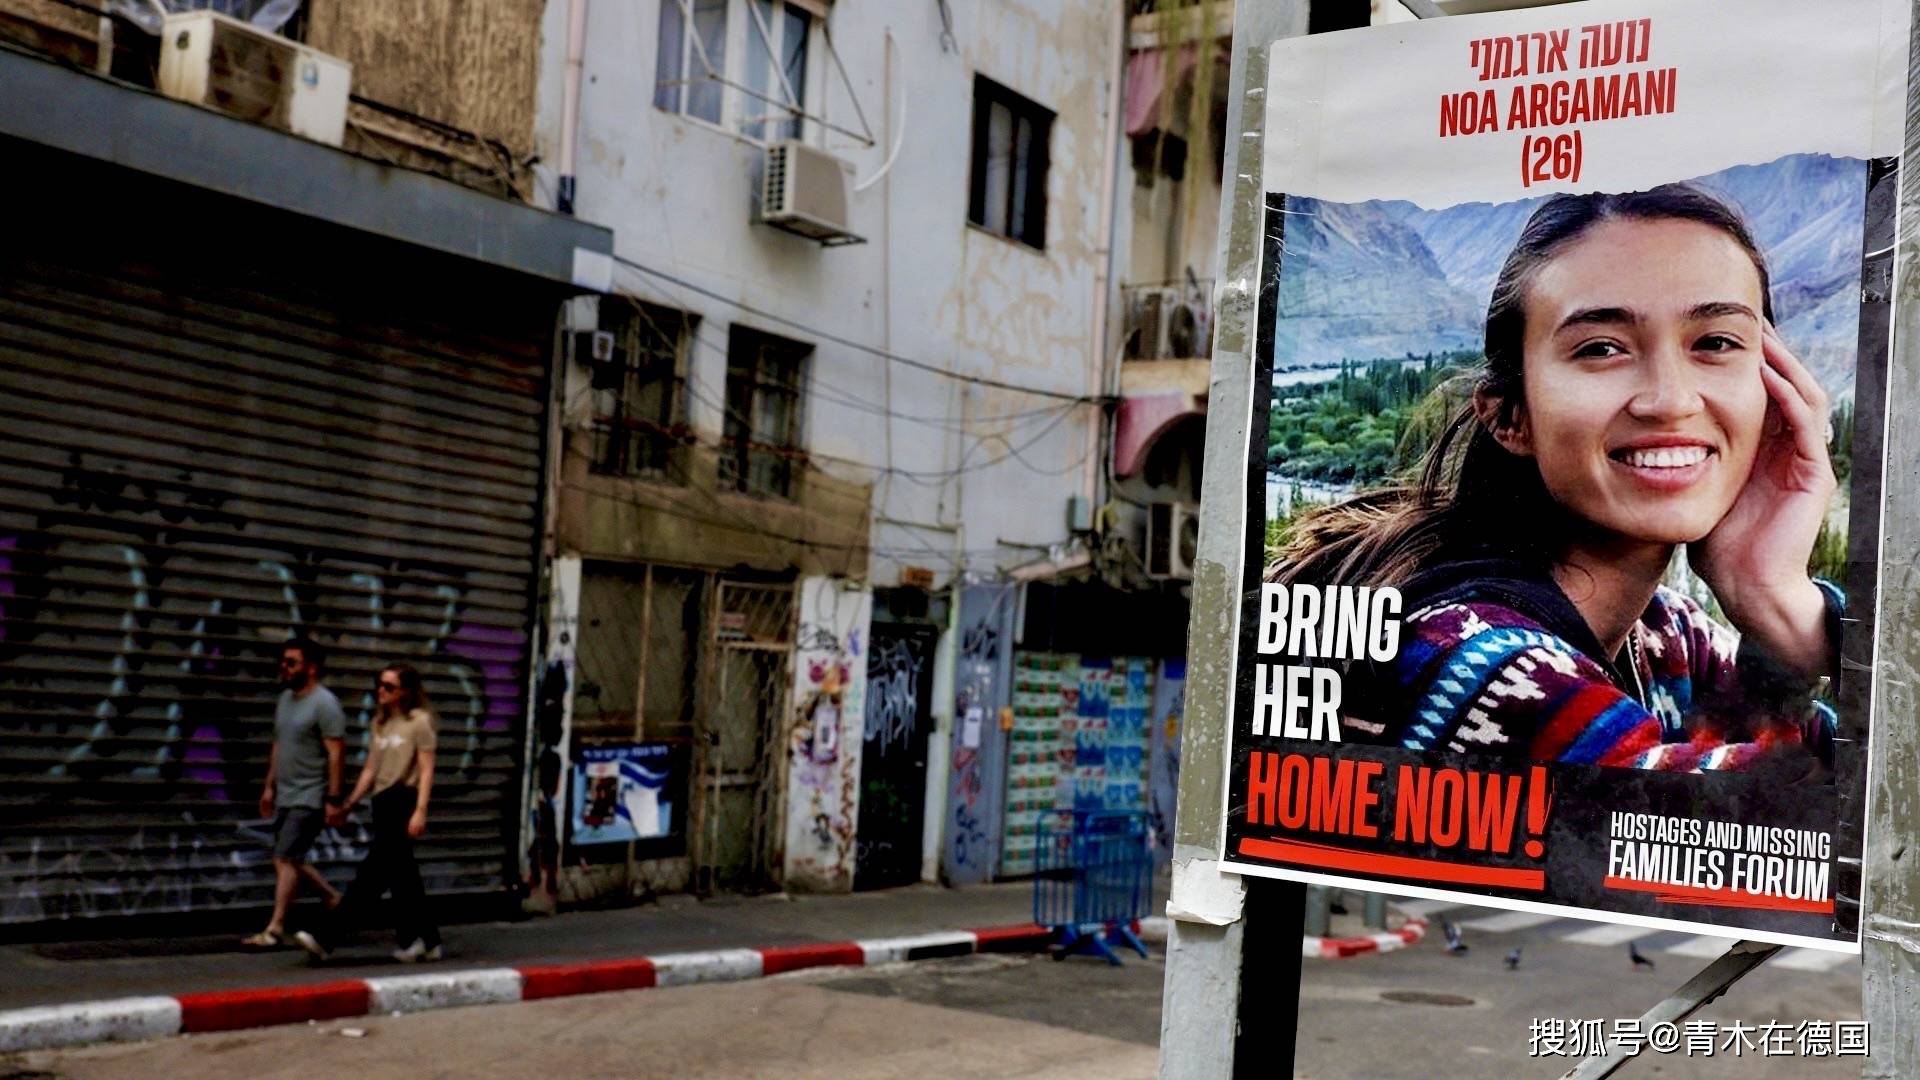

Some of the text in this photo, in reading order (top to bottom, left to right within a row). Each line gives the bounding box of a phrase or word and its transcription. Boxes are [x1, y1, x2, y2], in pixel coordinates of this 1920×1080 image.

[1470, 18, 1652, 81] נועה ארגמני
[1439, 68, 1677, 138] NOA ARGAMANI
[1521, 130, 1583, 188] (26)
[1257, 581, 1403, 663] BRING
[1251, 663, 1342, 743] HER
[1246, 751, 1554, 859] HOME NOW!
[1610, 811, 1831, 860] HOSTAGES AND MISSING
[1608, 839, 1830, 903] FAMILIES FORUM
